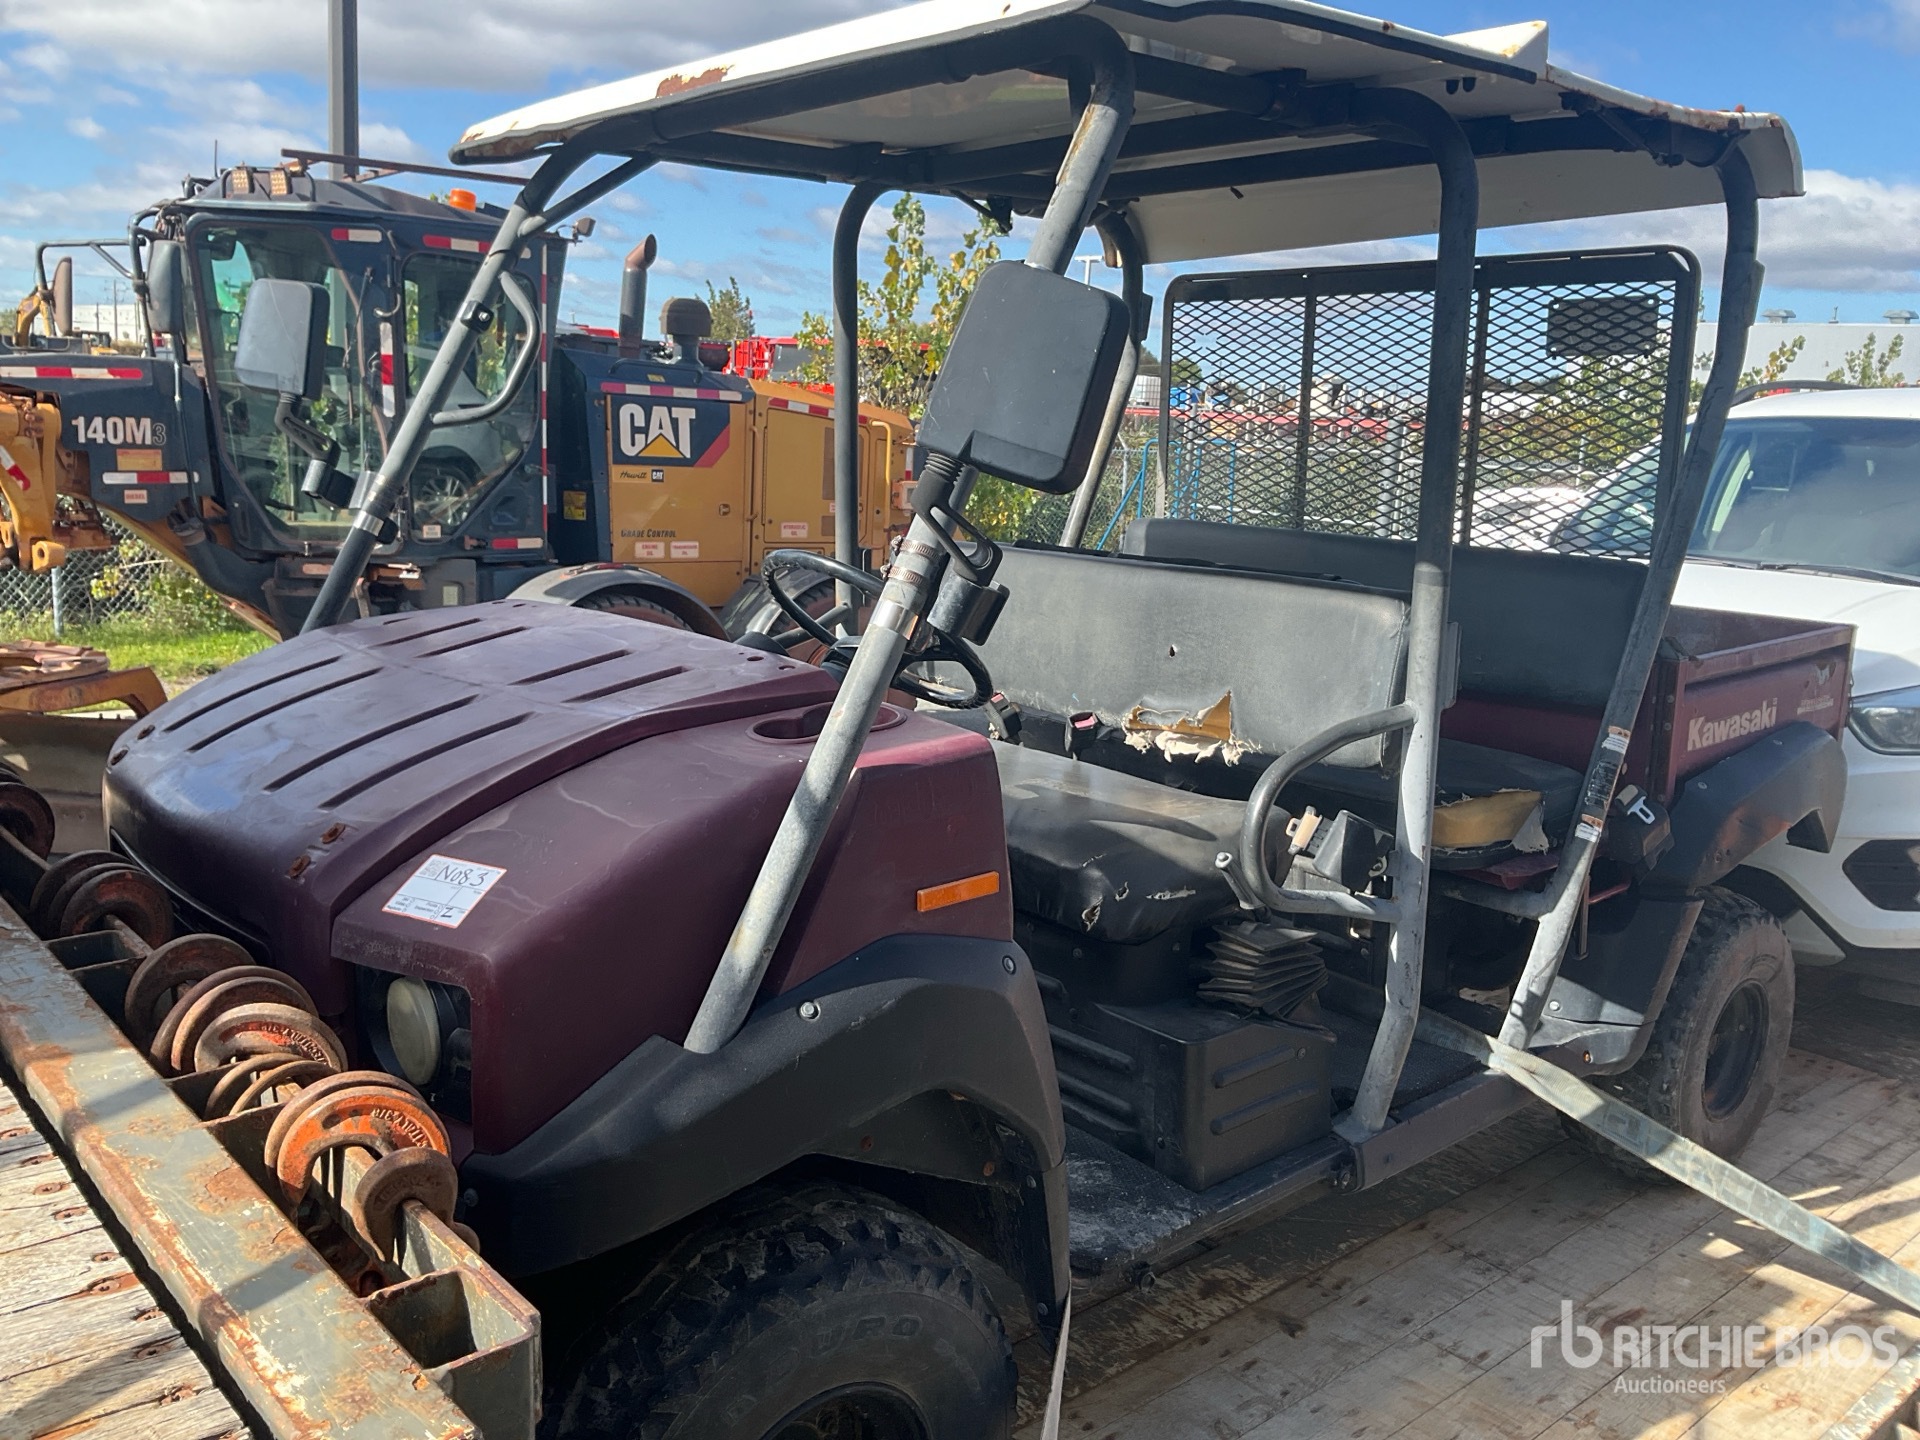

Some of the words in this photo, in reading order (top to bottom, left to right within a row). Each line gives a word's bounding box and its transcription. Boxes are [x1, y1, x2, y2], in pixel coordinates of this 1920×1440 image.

[619, 403, 696, 459] CAT
[652, 472, 664, 480] CAT
[1687, 698, 1777, 751] Kawasaki
